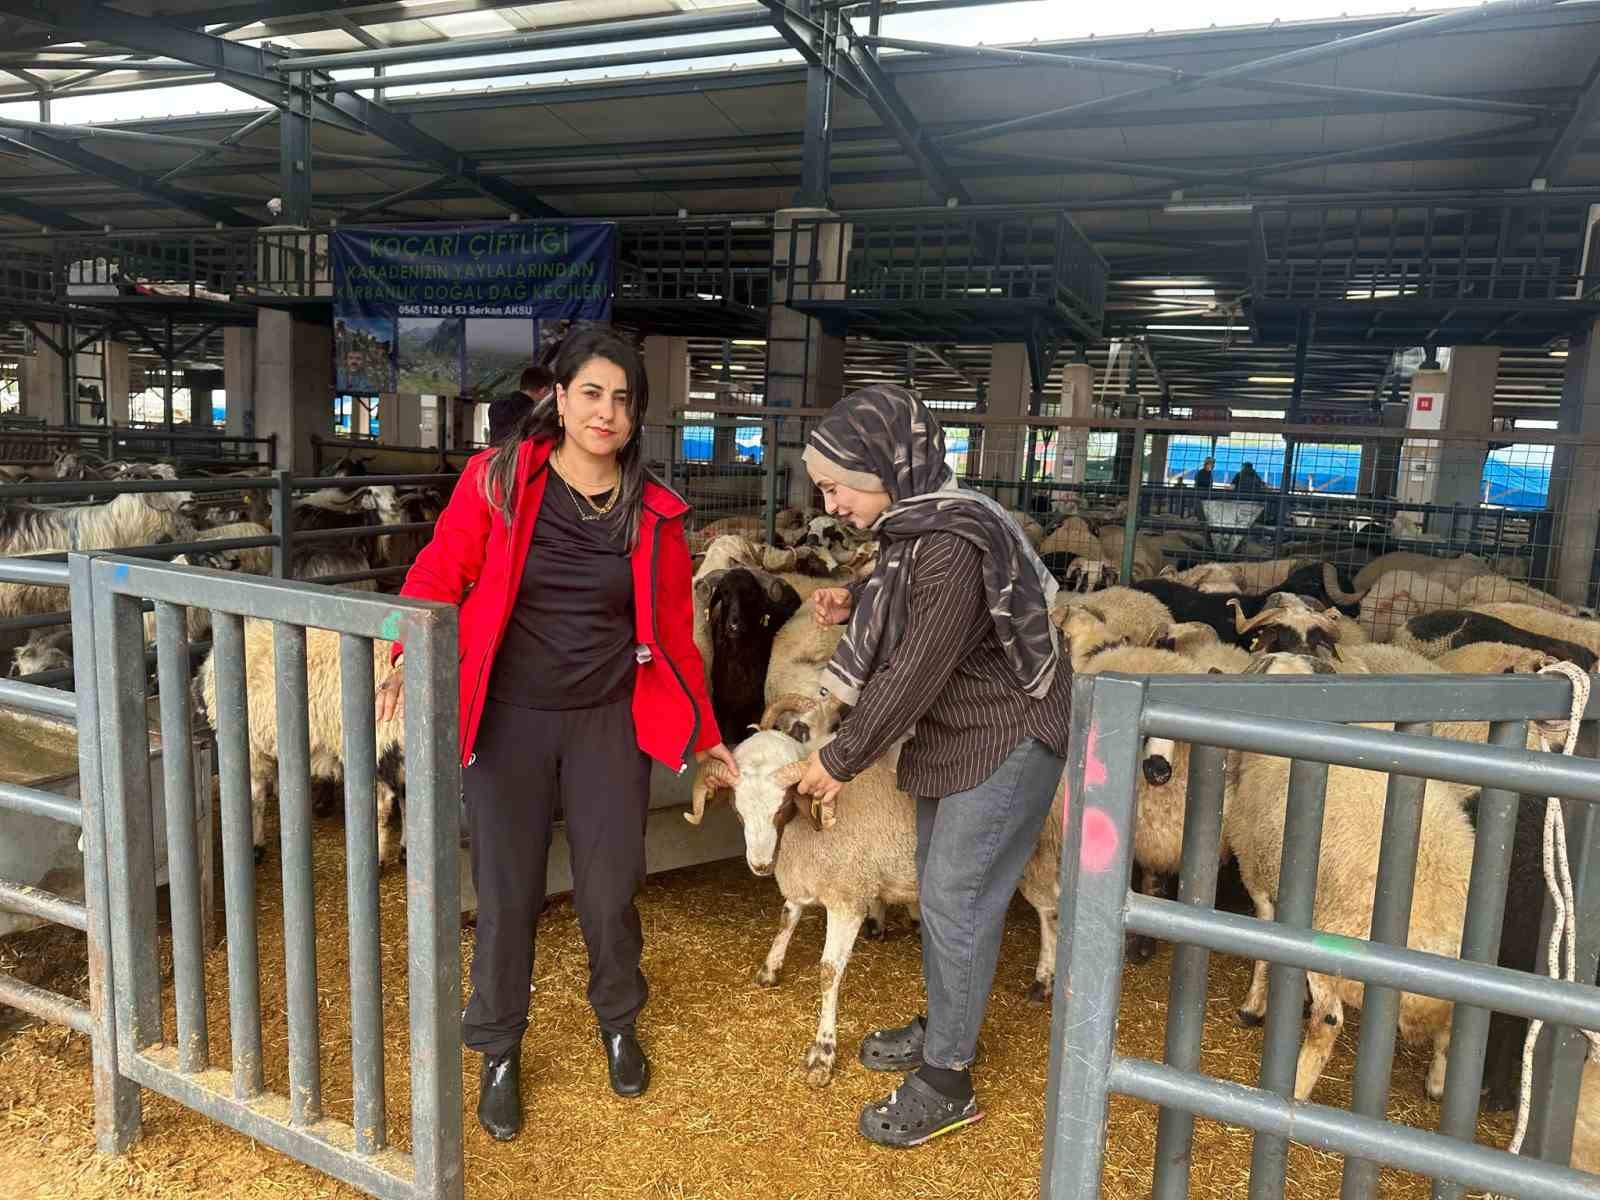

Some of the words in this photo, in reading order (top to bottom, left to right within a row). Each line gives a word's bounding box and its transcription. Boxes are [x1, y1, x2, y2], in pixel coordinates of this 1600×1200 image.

[369, 231, 460, 260] KOÇARİ
[468, 225, 570, 260] ÇİFTLİĞİ
[455, 261, 595, 279] YAYLALARINDAN
[424, 281, 483, 301] DOĞAL
[490, 281, 528, 300] DAĞ
[422, 305, 439, 315] 712
[440, 305, 453, 315] 04
[454, 305, 467, 315] 53
[468, 305, 503, 316] Serkan
[504, 305, 533, 316] AKSU
